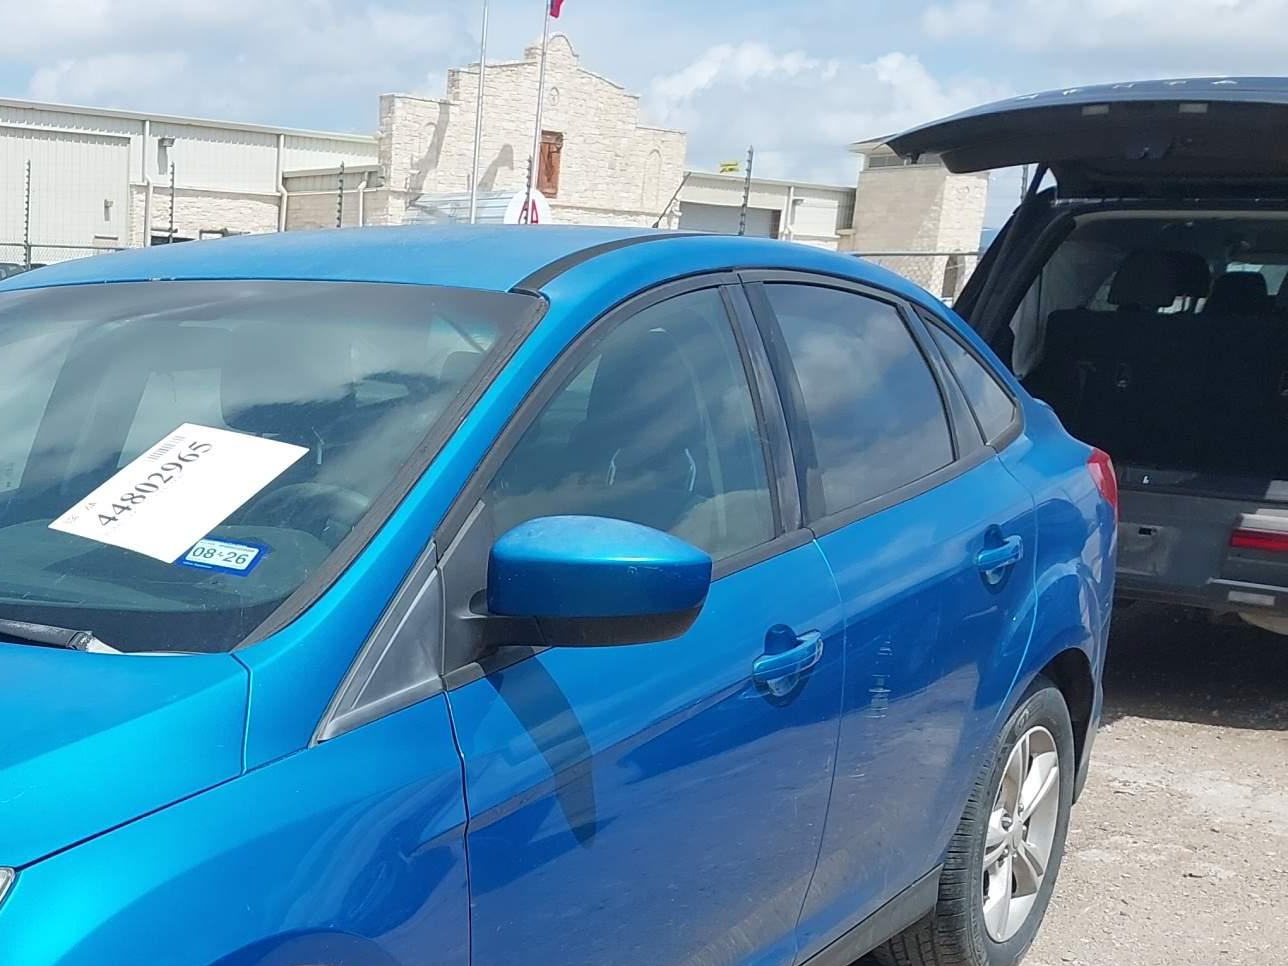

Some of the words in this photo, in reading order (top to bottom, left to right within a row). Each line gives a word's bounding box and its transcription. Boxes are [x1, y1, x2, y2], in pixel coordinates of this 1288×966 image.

[98, 441, 213, 527] 44802965
[192, 546, 217, 559] 08
[223, 551, 249, 565] 26
